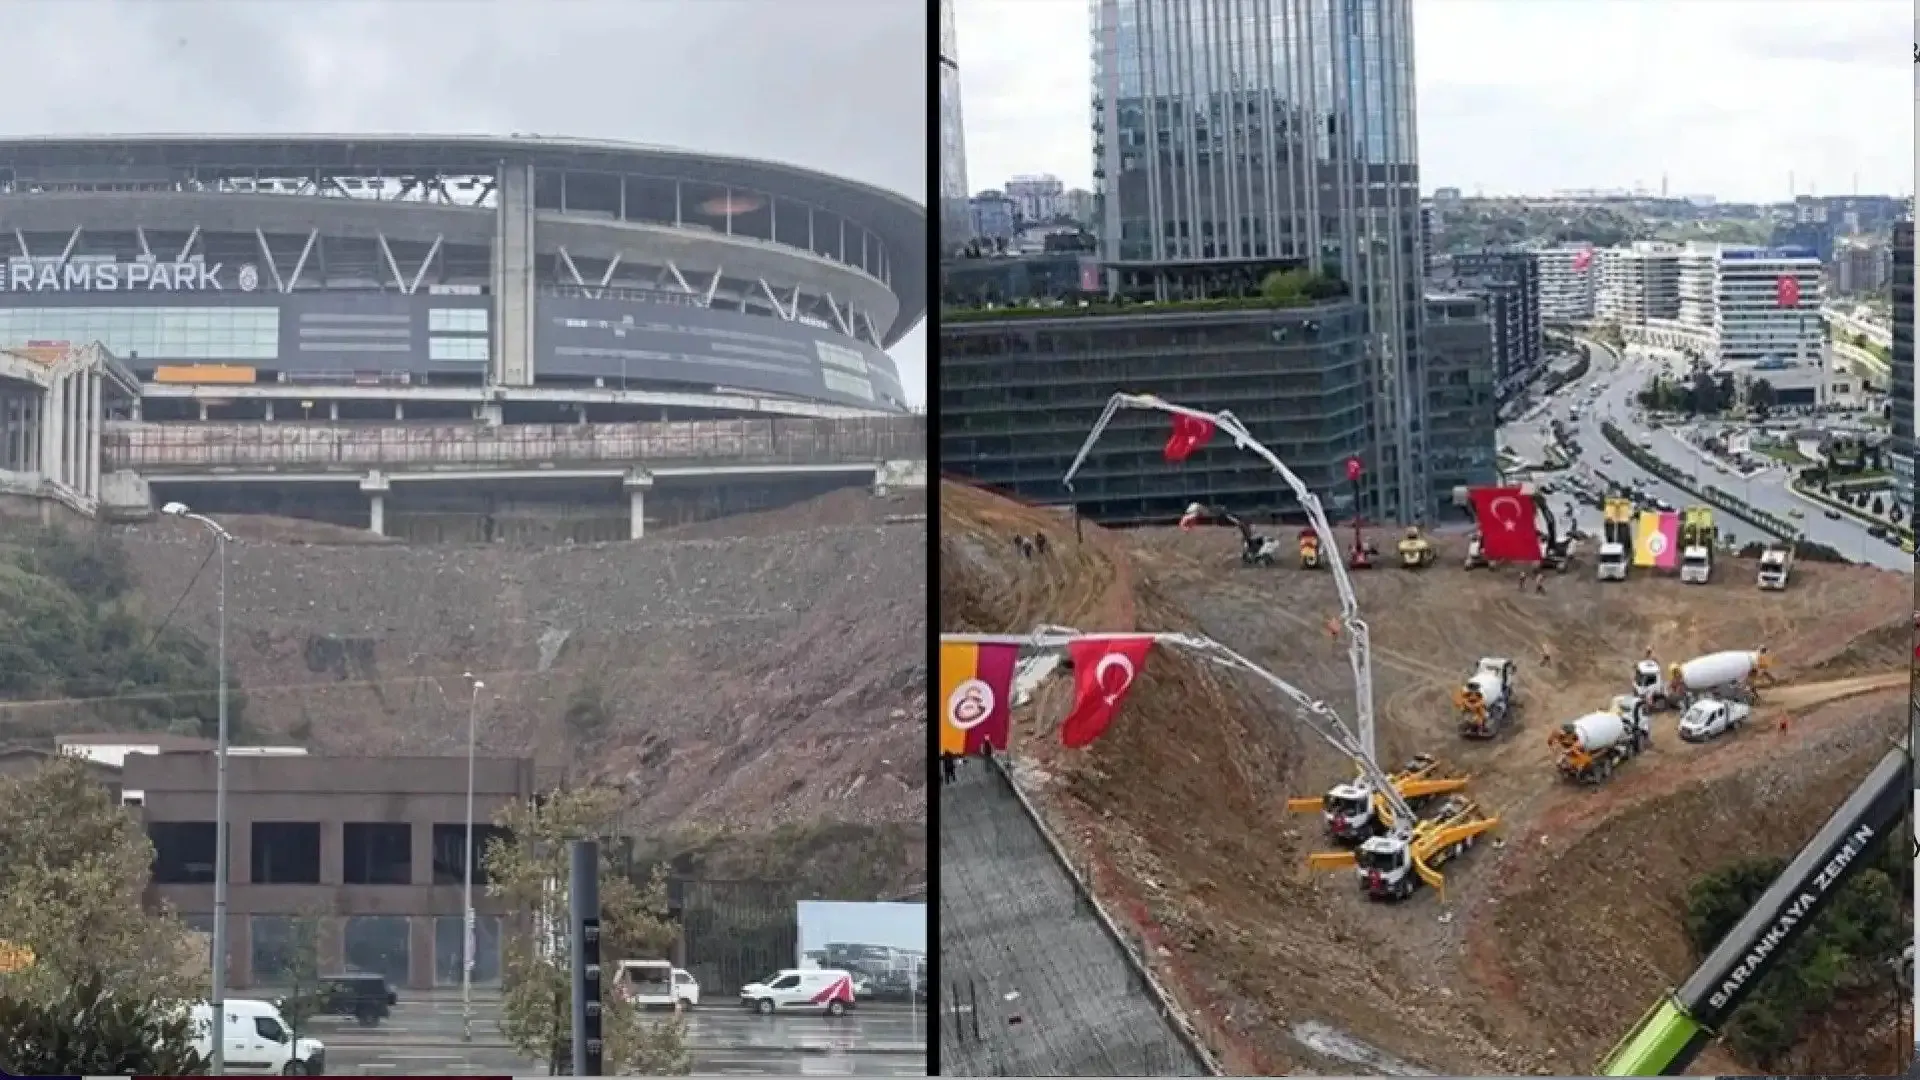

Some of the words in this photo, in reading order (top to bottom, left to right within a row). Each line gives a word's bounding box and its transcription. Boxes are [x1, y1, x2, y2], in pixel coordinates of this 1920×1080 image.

[11, 264, 118, 291] RAMS
[127, 263, 222, 291] PARK
[1709, 893, 1816, 1008] BARANKAYA
